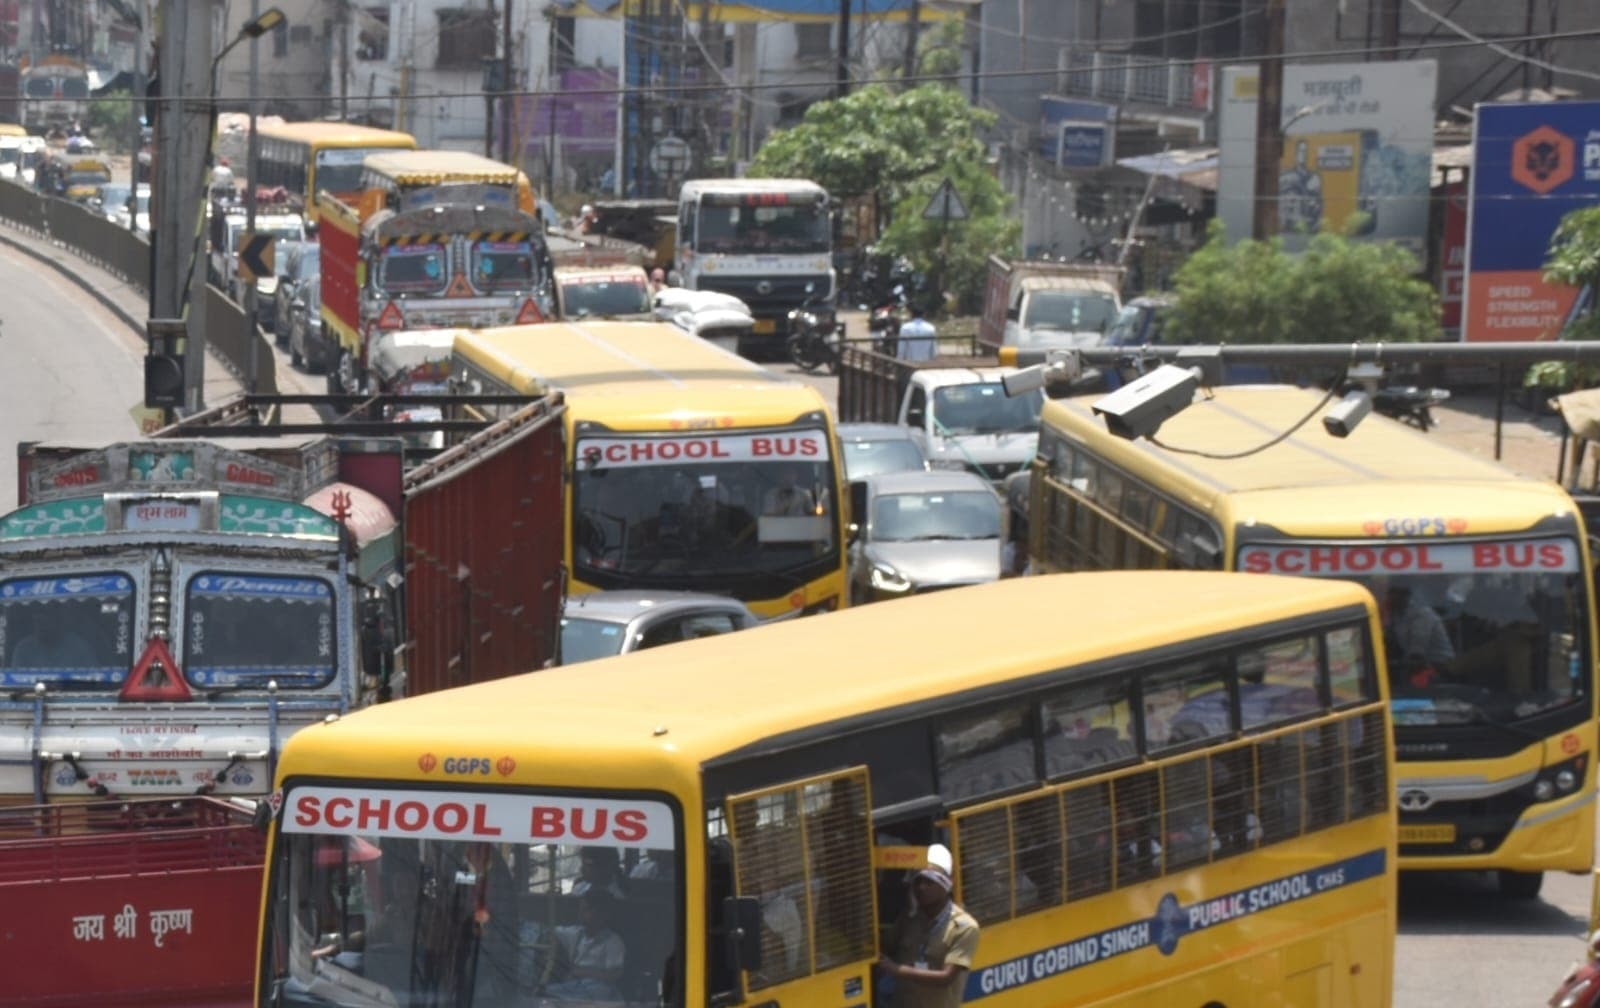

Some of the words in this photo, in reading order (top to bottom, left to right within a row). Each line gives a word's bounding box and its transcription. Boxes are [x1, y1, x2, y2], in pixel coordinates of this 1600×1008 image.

[1488, 286, 1532, 298] SPEED
[1487, 300, 1557, 312] STRENGTH
[1486, 314, 1561, 329] FLEXIBILITY
[583, 440, 730, 463] SCHOOL
[751, 438, 818, 457] BUS
[1384, 518, 1447, 535] GGPS
[1244, 546, 1442, 574] SCHOOL
[1472, 543, 1565, 568] BUS
[443, 757, 491, 776] GGPS
[127, 769, 182, 786] TATA
[294, 795, 503, 836] SCHOOL
[530, 806, 649, 842] BUS
[72, 914, 105, 941] जय
[113, 903, 138, 940] श्री
[149, 908, 193, 947] कृष्ण
[980, 957, 1029, 994] GURU
[1032, 937, 1099, 979] GOBIND
[1101, 921, 1150, 958] SINGH
[1189, 893, 1246, 930] PUBLIC
[1248, 874, 1312, 913] SCHOOL
[1316, 868, 1345, 891] CHAS
